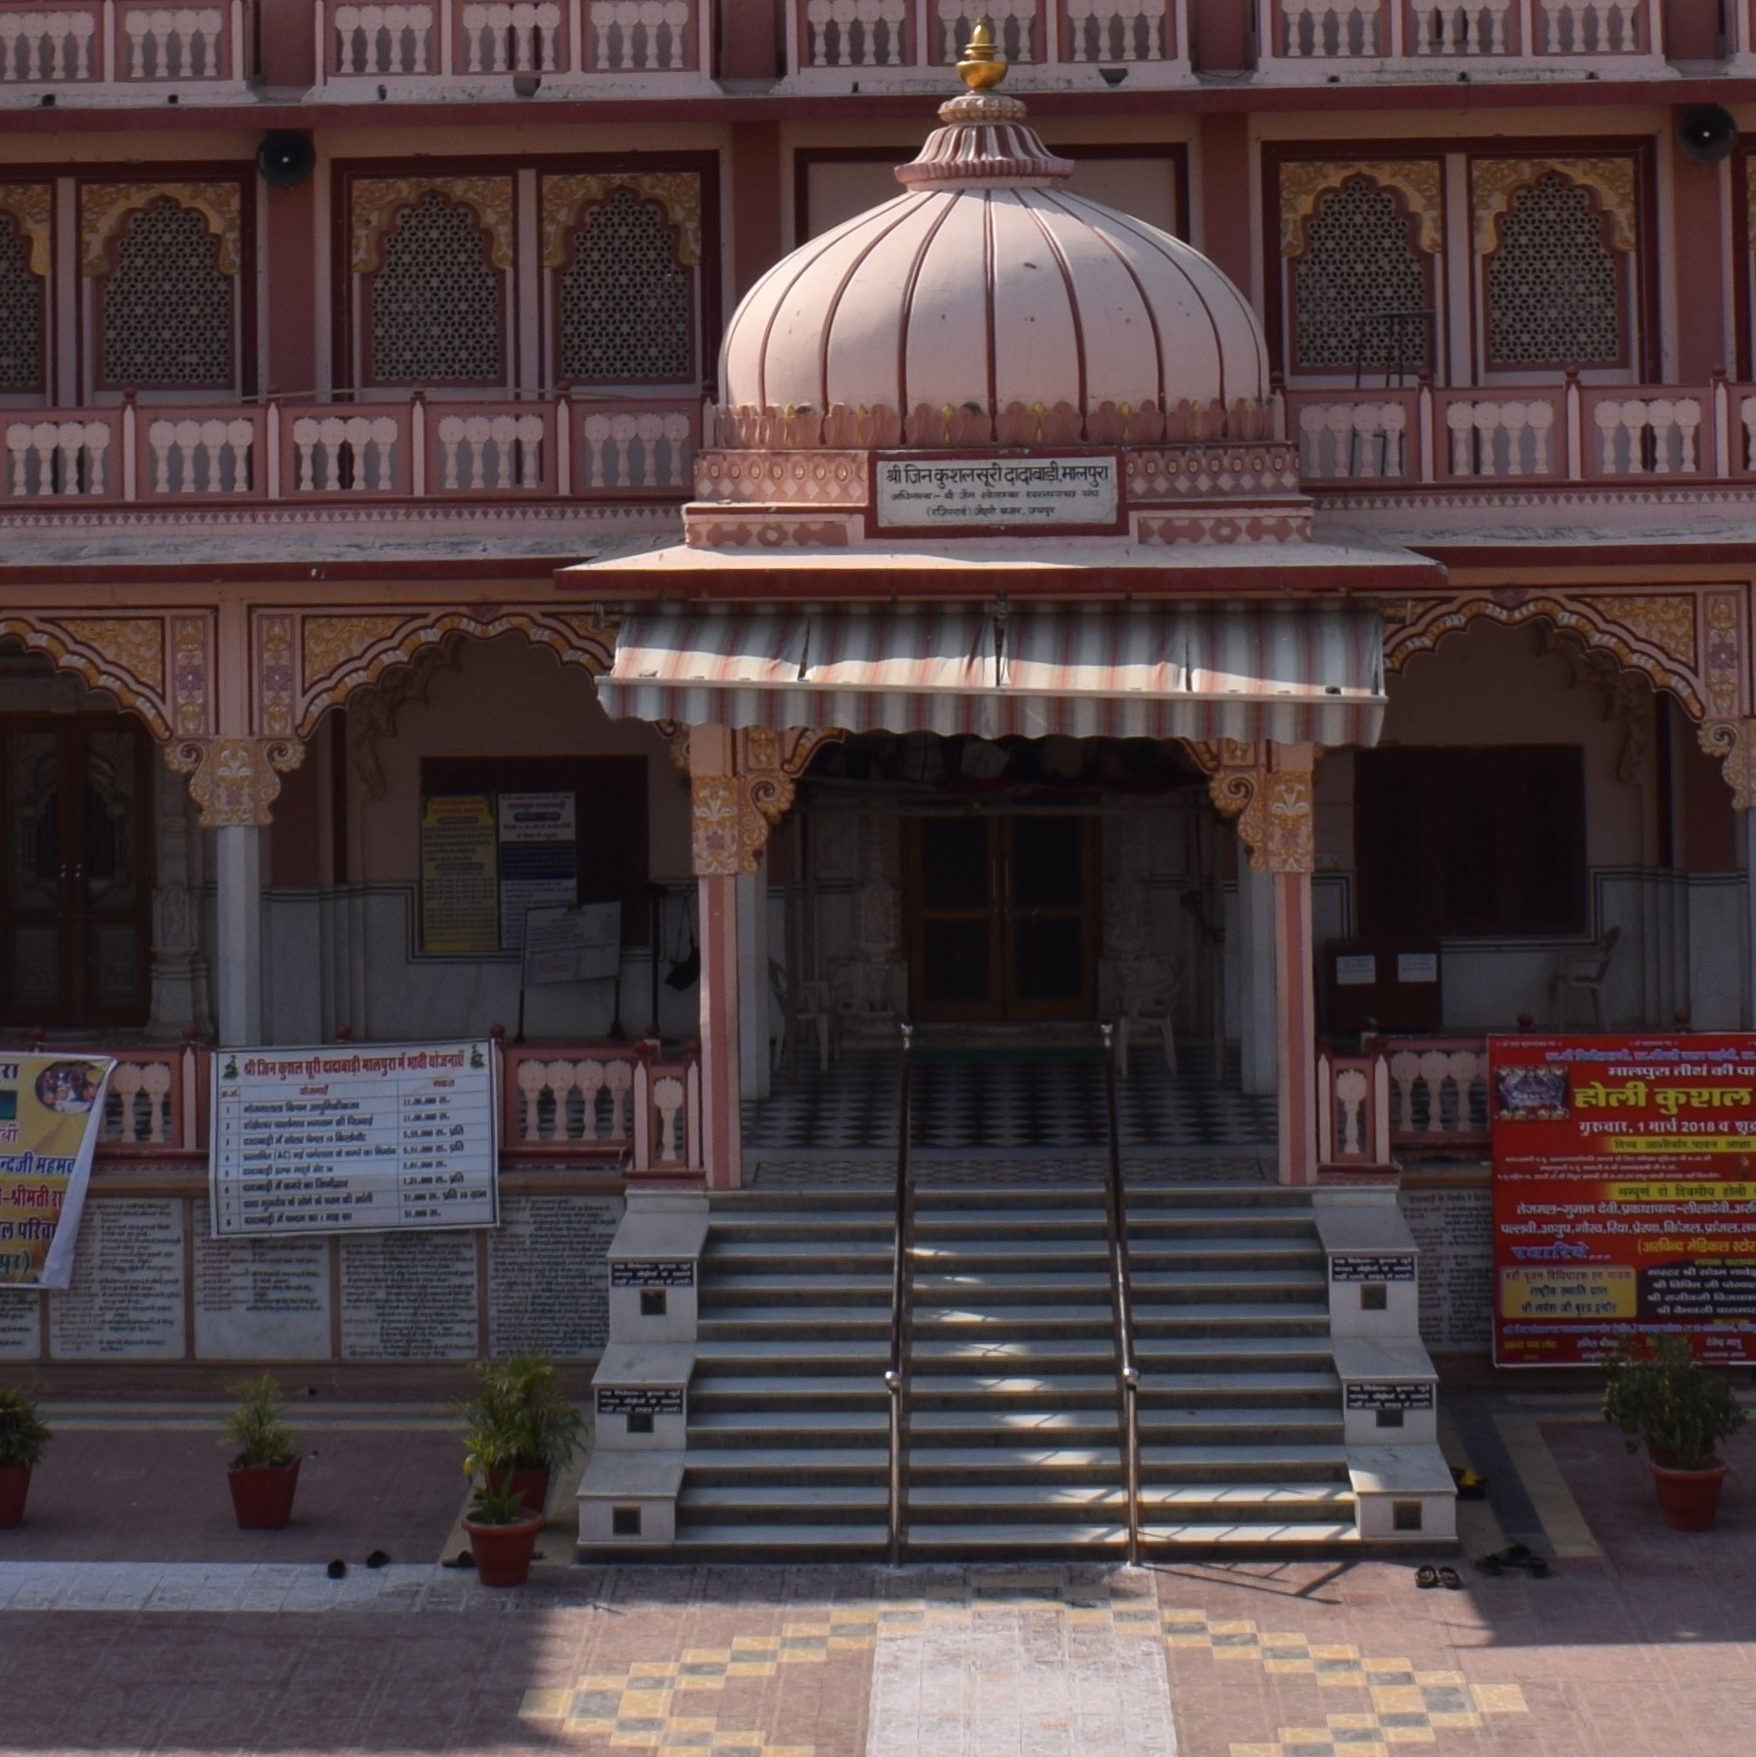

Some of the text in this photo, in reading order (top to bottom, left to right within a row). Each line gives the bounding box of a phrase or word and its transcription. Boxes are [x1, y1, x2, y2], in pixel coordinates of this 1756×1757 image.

[886, 465, 901, 484] श्री
[905, 464, 931, 484] जिन
[244, 1059, 255, 1076] श्री
[257, 1059, 276, 1076] जिन
[362, 1058, 396, 1077] मालपुरा
[1607, 1066, 1670, 1080] मालपुरा
[1711, 1063, 1733, 1076] की
[1573, 1081, 1649, 1108] होली
[1654, 1087, 1753, 1115] कुशल
[1637, 1121, 1644, 1133] 1
[1648, 1117, 1676, 1133] मार्च
[1680, 1121, 1715, 1133] 2018
[1722, 1184, 1747, 1196] होली
